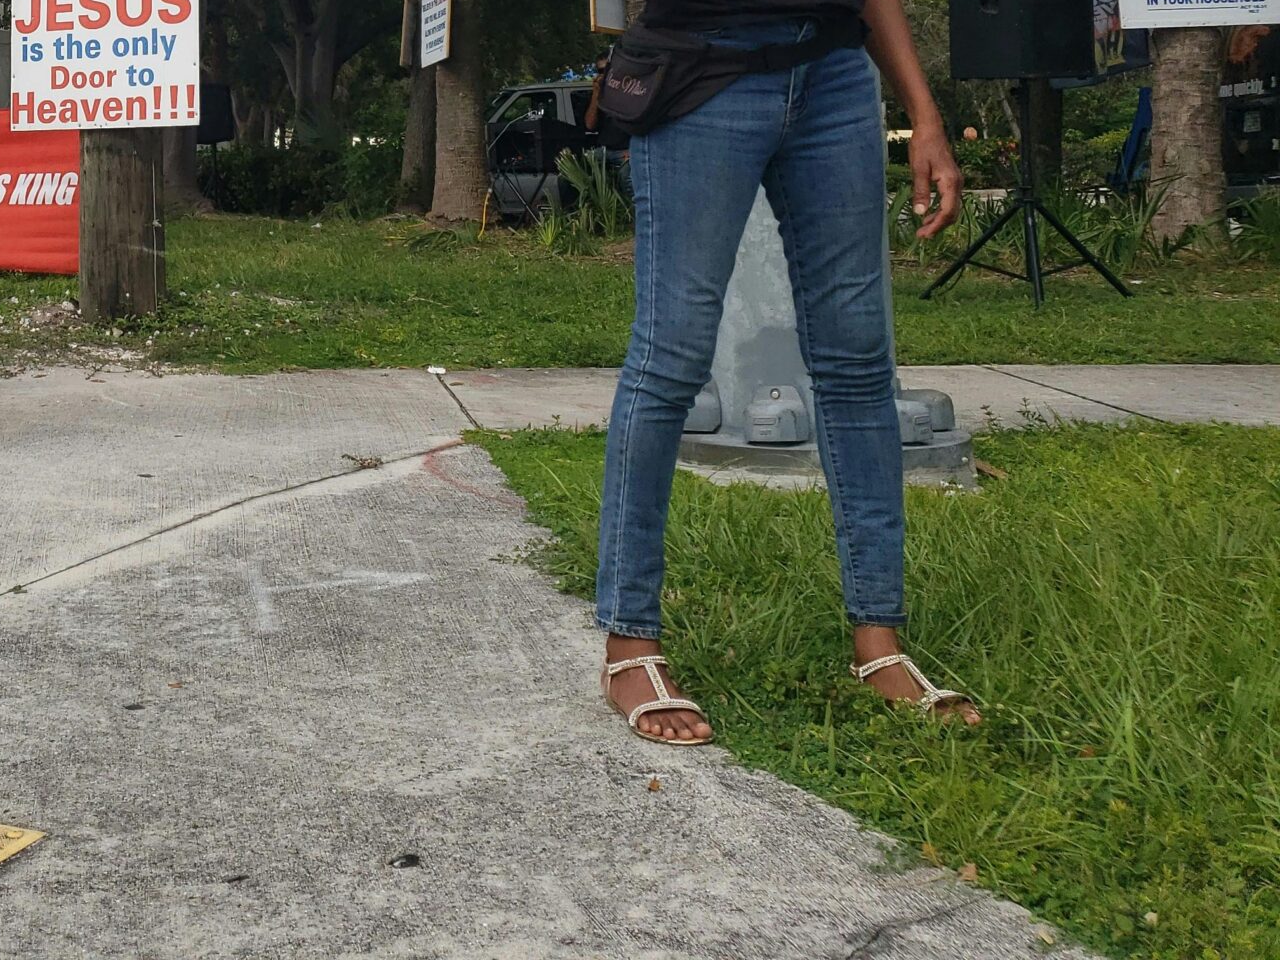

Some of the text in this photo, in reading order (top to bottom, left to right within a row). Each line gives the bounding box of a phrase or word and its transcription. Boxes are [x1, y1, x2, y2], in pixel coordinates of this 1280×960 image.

[22, 28, 177, 62] is the only
[51, 65, 155, 90] Door to
[12, 85, 196, 125] Heaven!!!
[8, 172, 79, 206] KING
